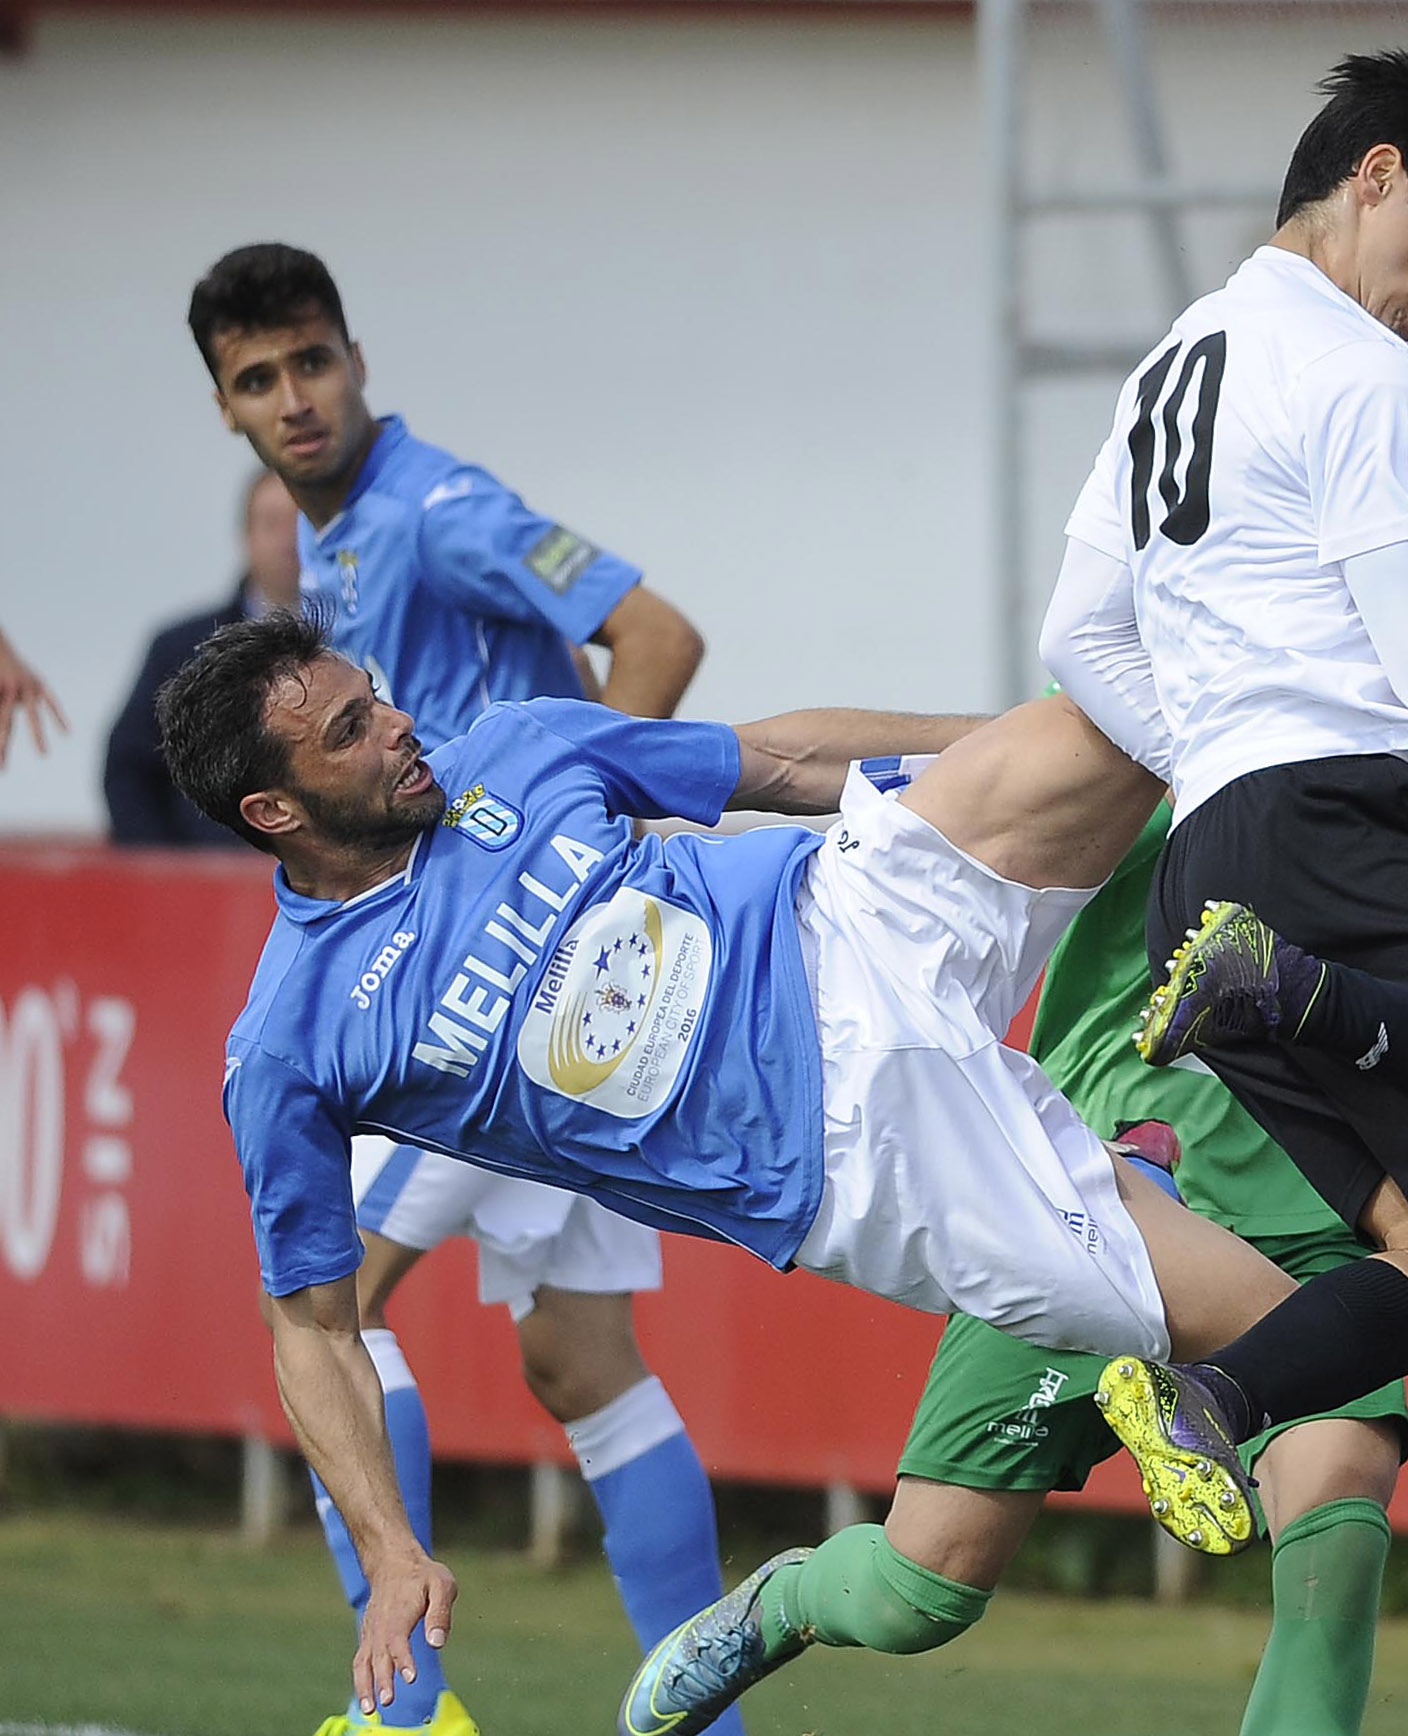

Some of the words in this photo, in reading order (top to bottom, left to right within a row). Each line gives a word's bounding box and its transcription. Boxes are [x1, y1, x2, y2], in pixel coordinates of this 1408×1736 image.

[1128, 329, 1227, 552] 10
[411, 834, 605, 1079] MELILLA
[534, 938, 580, 1015] Melilla
[626, 1055, 649, 1097] CIUDAD
[643, 1005, 668, 1055] EUROPEA
[661, 984, 677, 1004] DEL
[669, 932, 694, 982] DEPORTE
[637, 1032, 673, 1103] EUROPEAN
[665, 999, 684, 1031] CITY
[676, 980, 690, 1000] OF
[683, 937, 705, 981] SPORT
[677, 1008, 697, 1042] 2016
